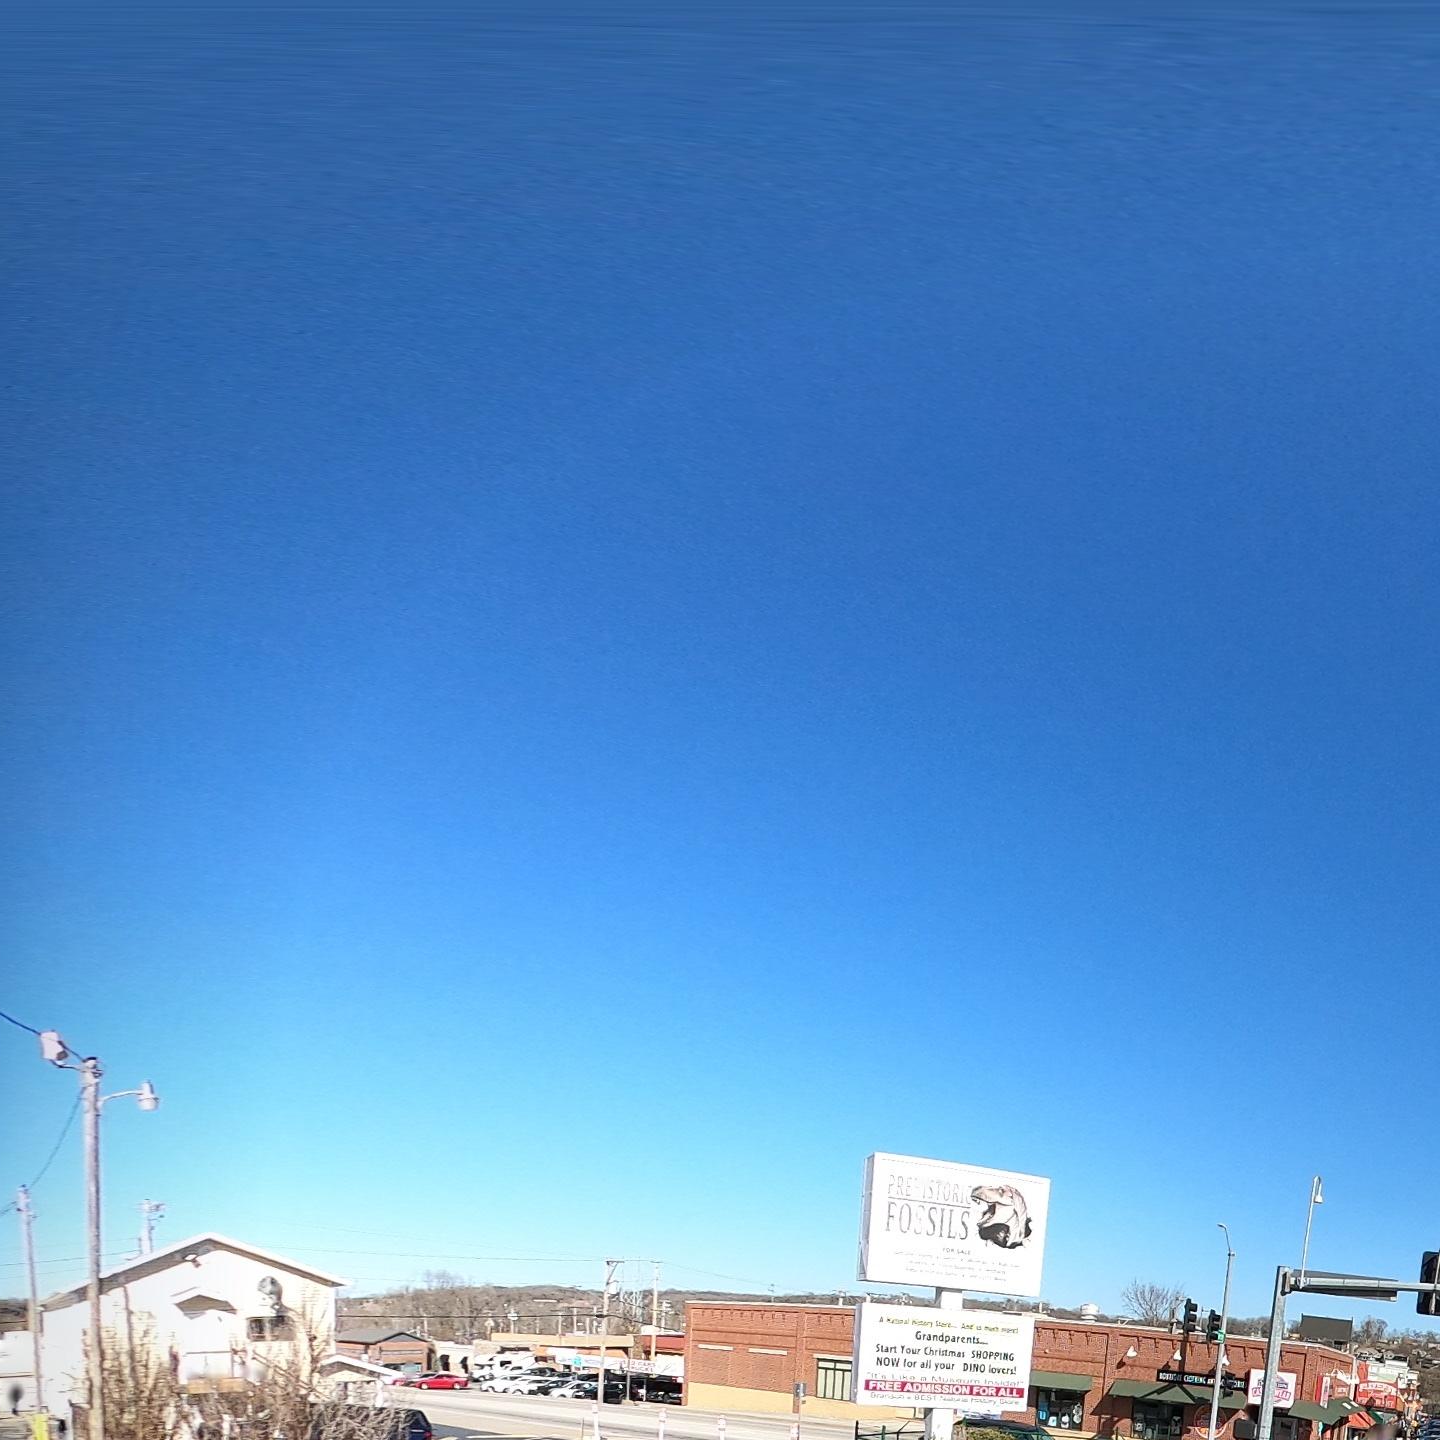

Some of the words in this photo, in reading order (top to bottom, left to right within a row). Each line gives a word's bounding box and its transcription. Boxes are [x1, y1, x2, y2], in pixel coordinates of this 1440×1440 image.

[885, 1201, 970, 1240] FOSSILS
[875, 1344, 898, 1354] Start
[900, 1346, 921, 1355] Your
[924, 1347, 965, 1358] Christmas
[971, 1350, 1015, 1361] SHOPPING
[876, 1357, 900, 1368] NOW
[903, 1358, 917, 1368] for
[920, 1359, 931, 1369] all
[934, 1361, 955, 1371] your
[962, 1363, 986, 1373] DINO
[988, 1364, 1017, 1375] lovers!
[868, 1381, 902, 1392] FREE
[903, 1382, 970, 1396] ADMISSION
[973, 1385, 998, 1396] FOR
[998, 1387, 1020, 1397] ALL
